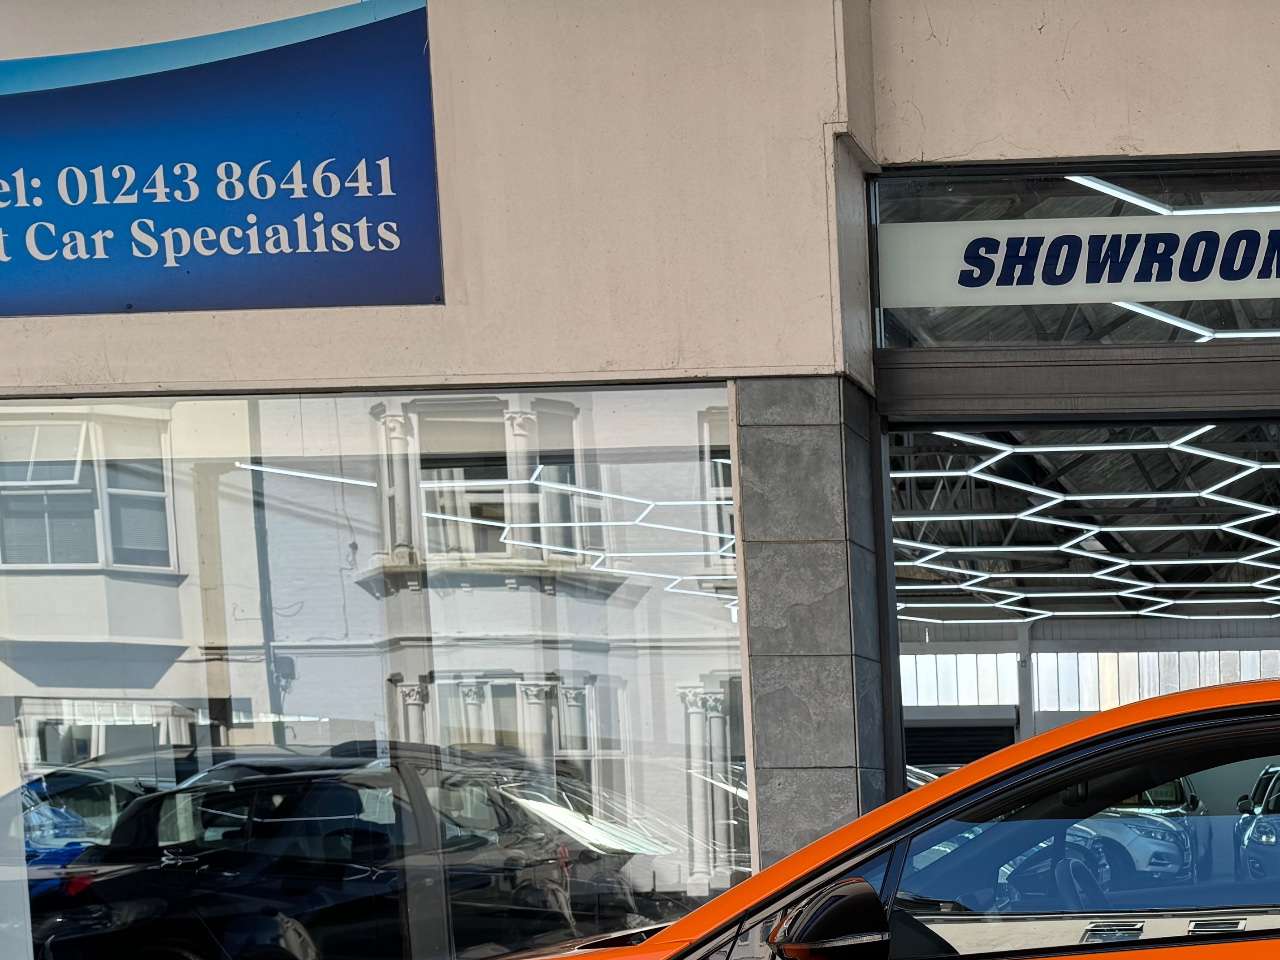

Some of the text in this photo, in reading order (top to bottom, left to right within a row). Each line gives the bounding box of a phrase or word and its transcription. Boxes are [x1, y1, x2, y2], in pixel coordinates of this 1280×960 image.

[57, 162, 200, 206] 01243
[216, 156, 397, 201] 864641
[25, 221, 114, 261] Car
[130, 211, 401, 268] Specialists
